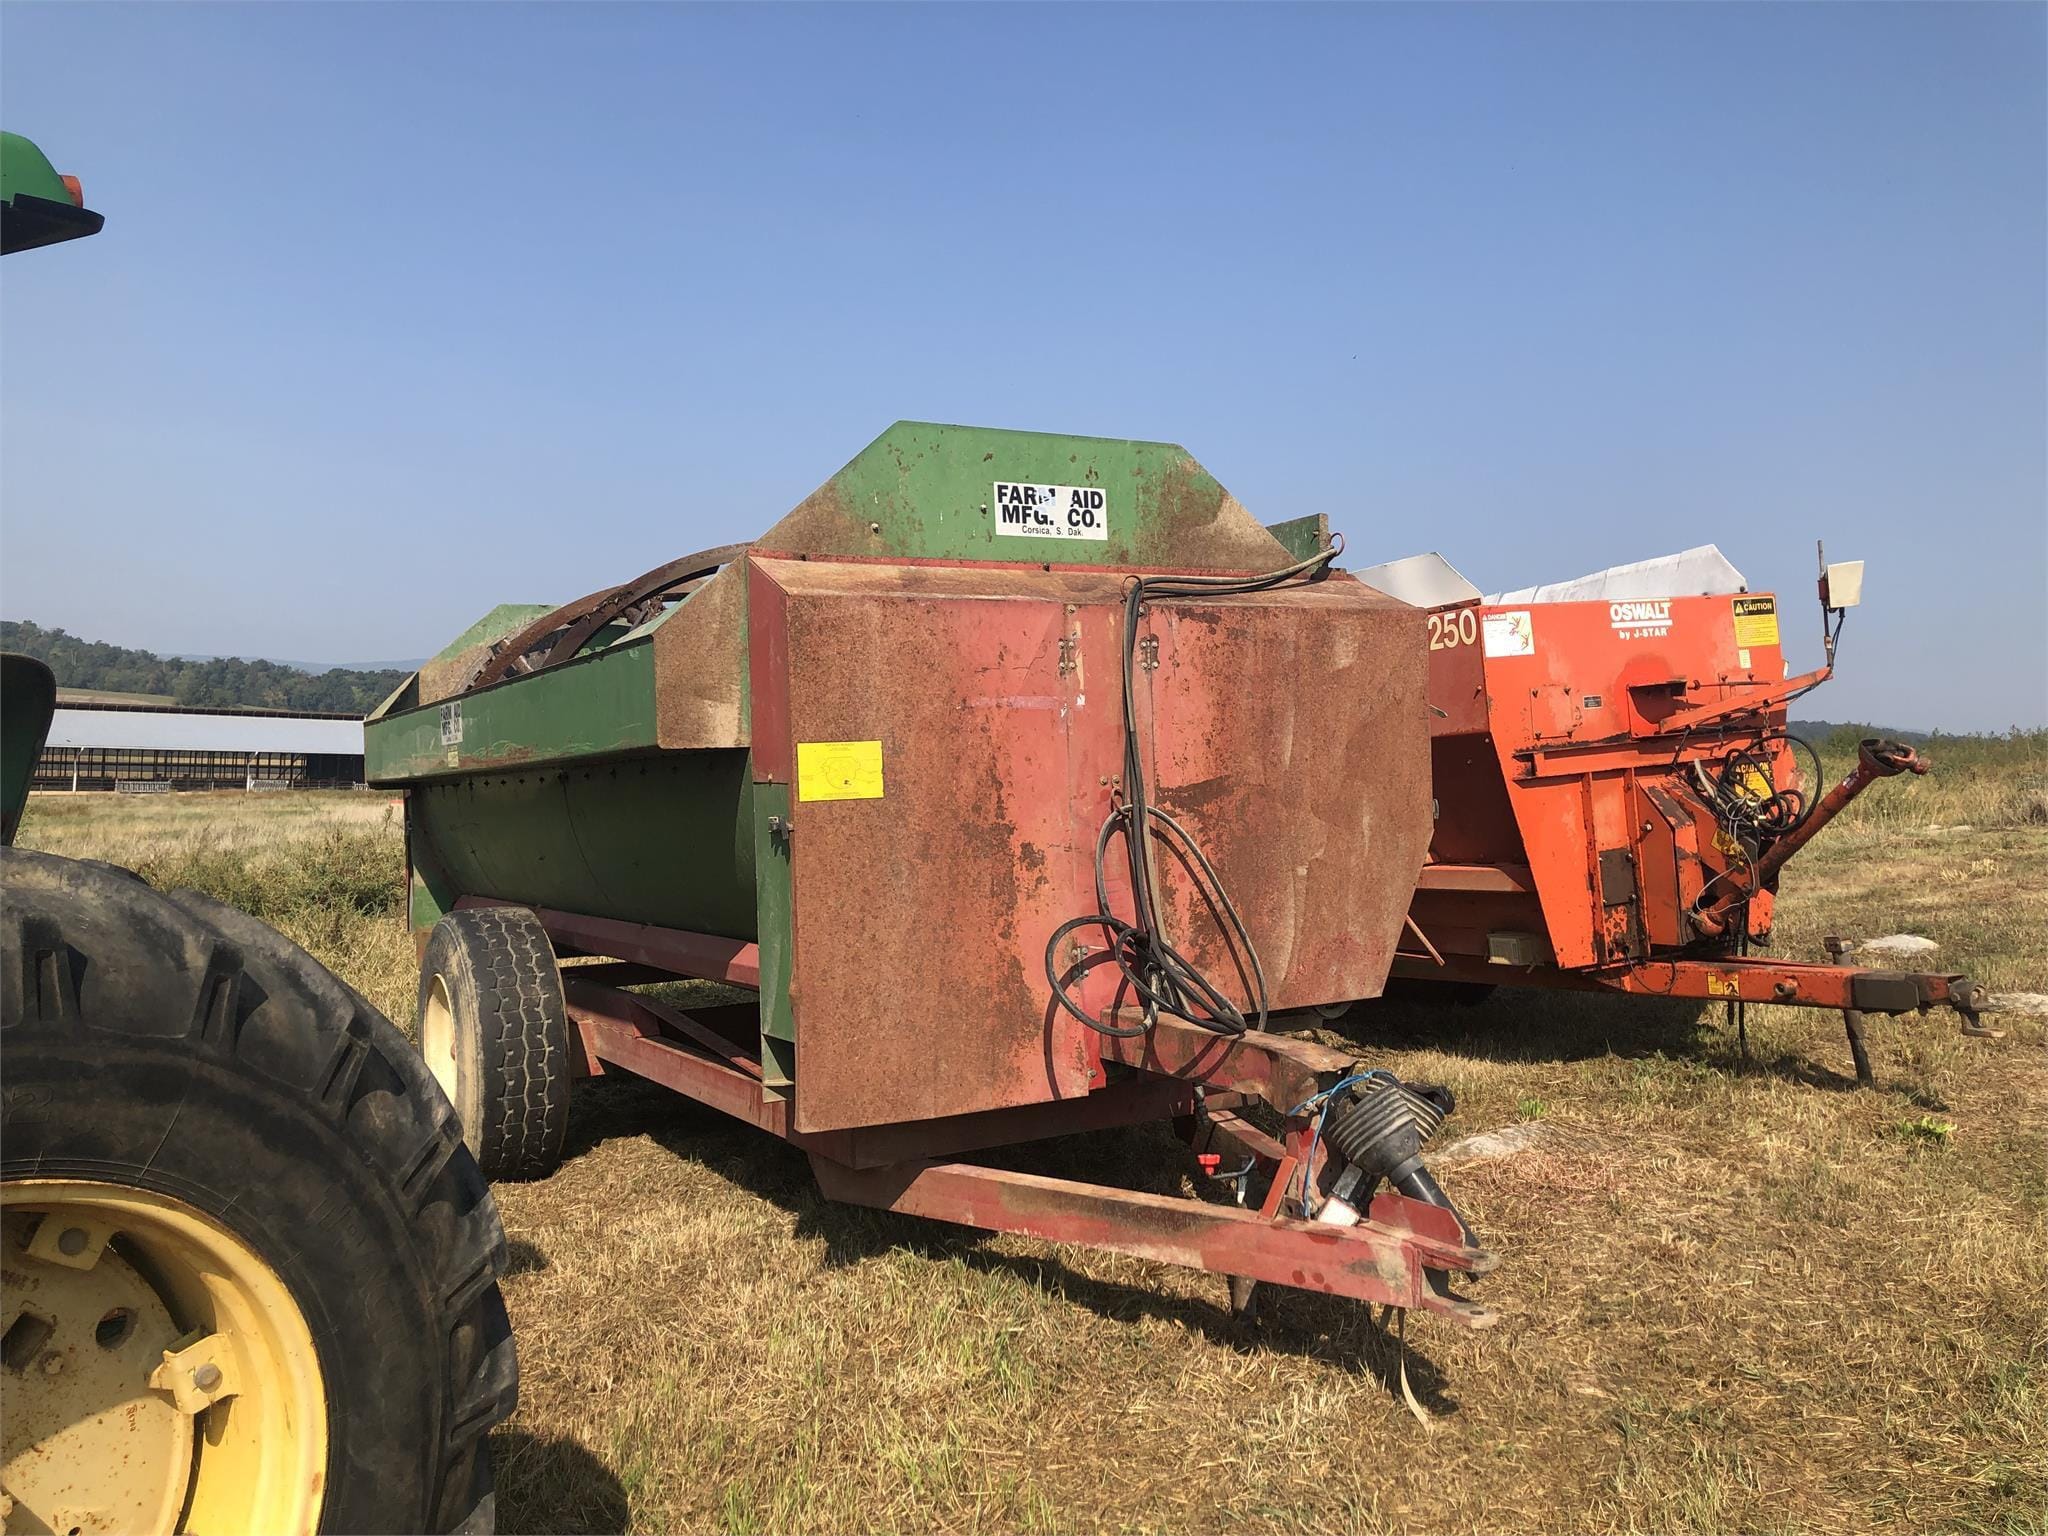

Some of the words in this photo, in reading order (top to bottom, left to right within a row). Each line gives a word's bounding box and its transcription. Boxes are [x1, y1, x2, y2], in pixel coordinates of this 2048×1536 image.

[1070, 490, 1104, 509] AID
[1002, 504, 1054, 526] MFG.
[1067, 508, 1101, 528] CO.
[1022, 525, 1052, 536] Corsica,
[1056, 527, 1064, 535] S.
[1068, 528, 1084, 537] Dak.
[1610, 602, 1672, 621] OSWALT
[1743, 603, 1772, 611] CAUTION
[1427, 608, 1477, 651] 250
[1619, 629, 1631, 640] by
[1634, 628, 1668, 638] J-STAR
[1741, 762, 1769, 774] CAUON
